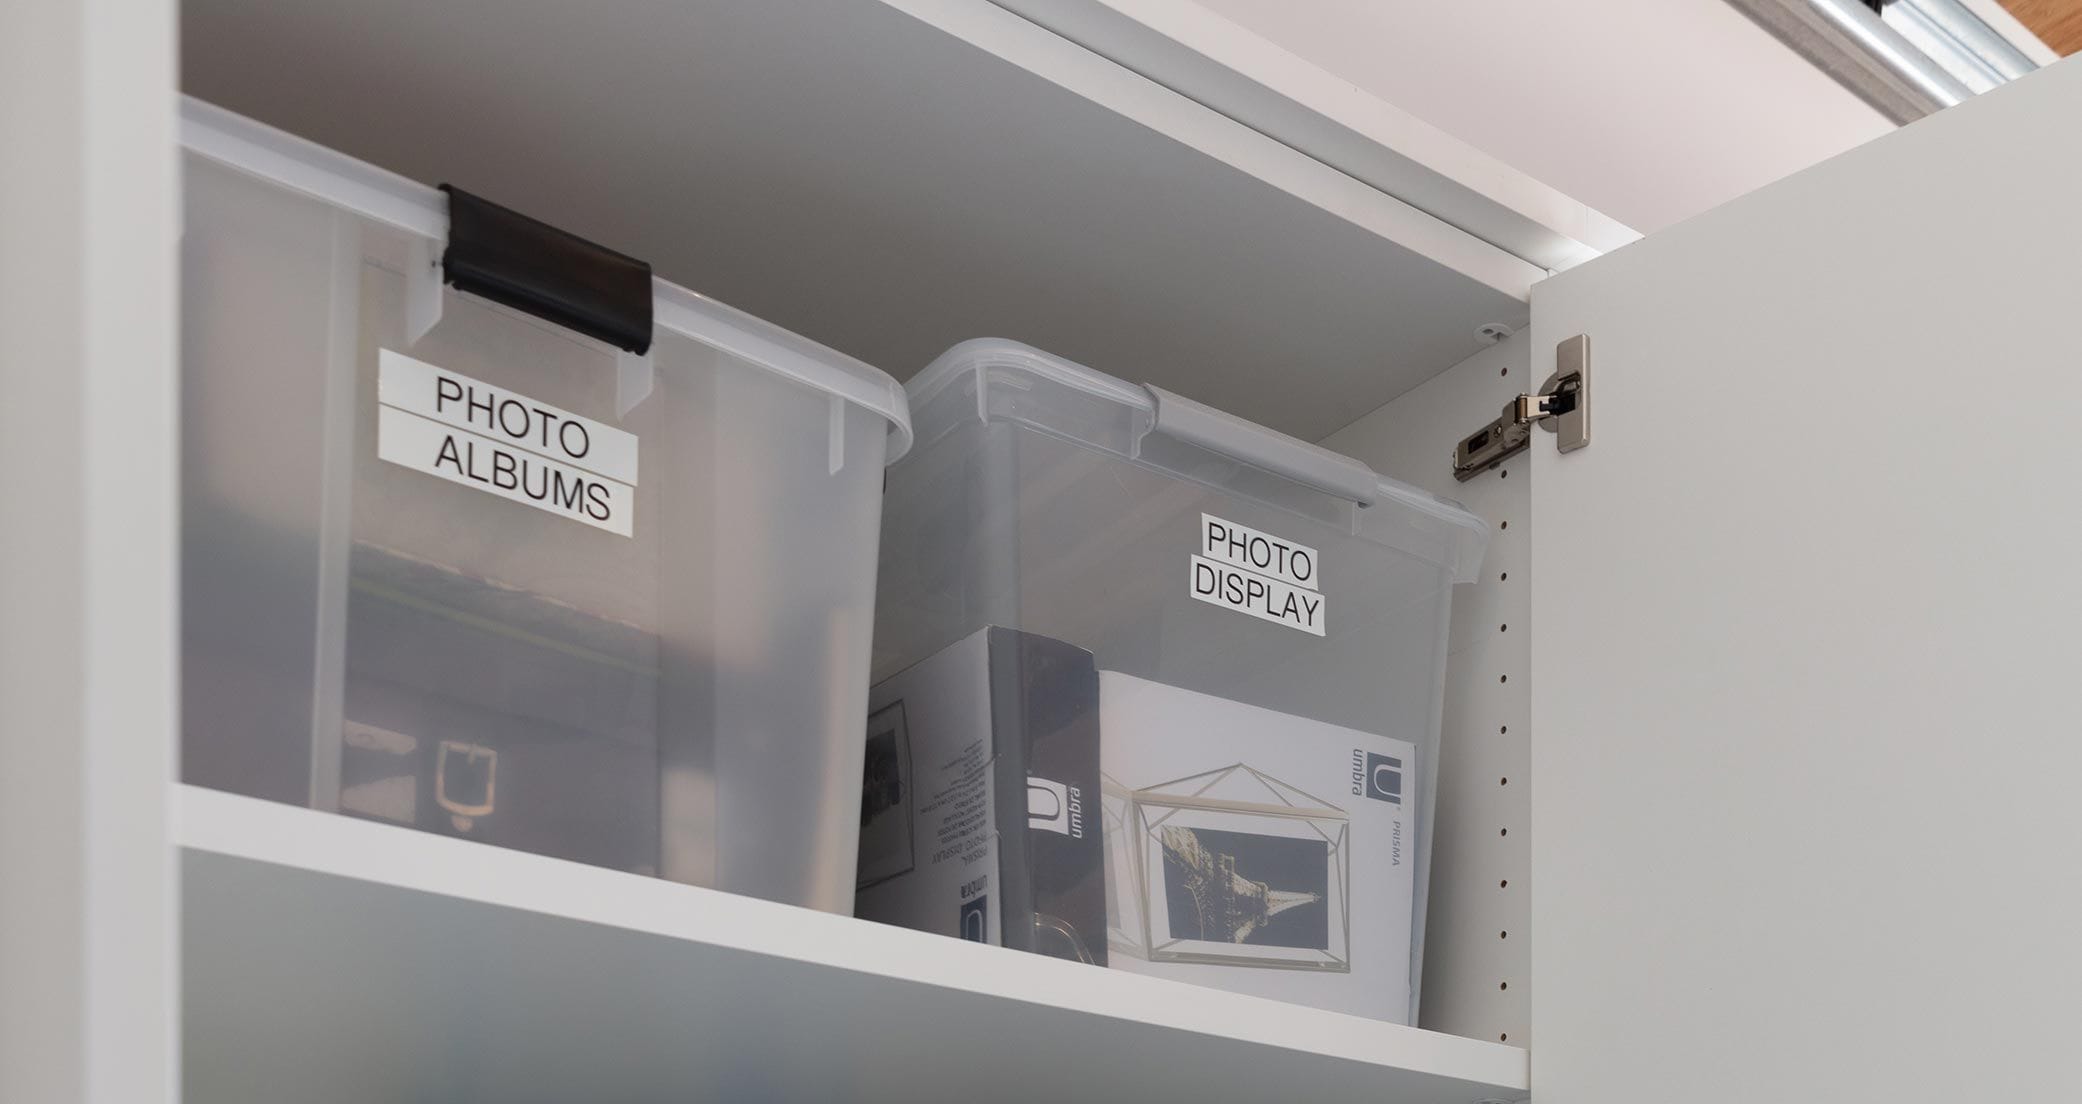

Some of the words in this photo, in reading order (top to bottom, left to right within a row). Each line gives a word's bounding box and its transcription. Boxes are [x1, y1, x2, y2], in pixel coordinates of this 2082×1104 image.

[437, 376, 589, 459] PHOTO
[434, 435, 611, 521] ALBUMS
[1208, 521, 1312, 581] PHOTO
[1196, 563, 1319, 626] DISPLAY
[1351, 748, 1365, 796] umbra
[1068, 786, 1082, 839] umbra
[1391, 821, 1401, 866] PRISMA
[960, 875, 988, 899] umbra
